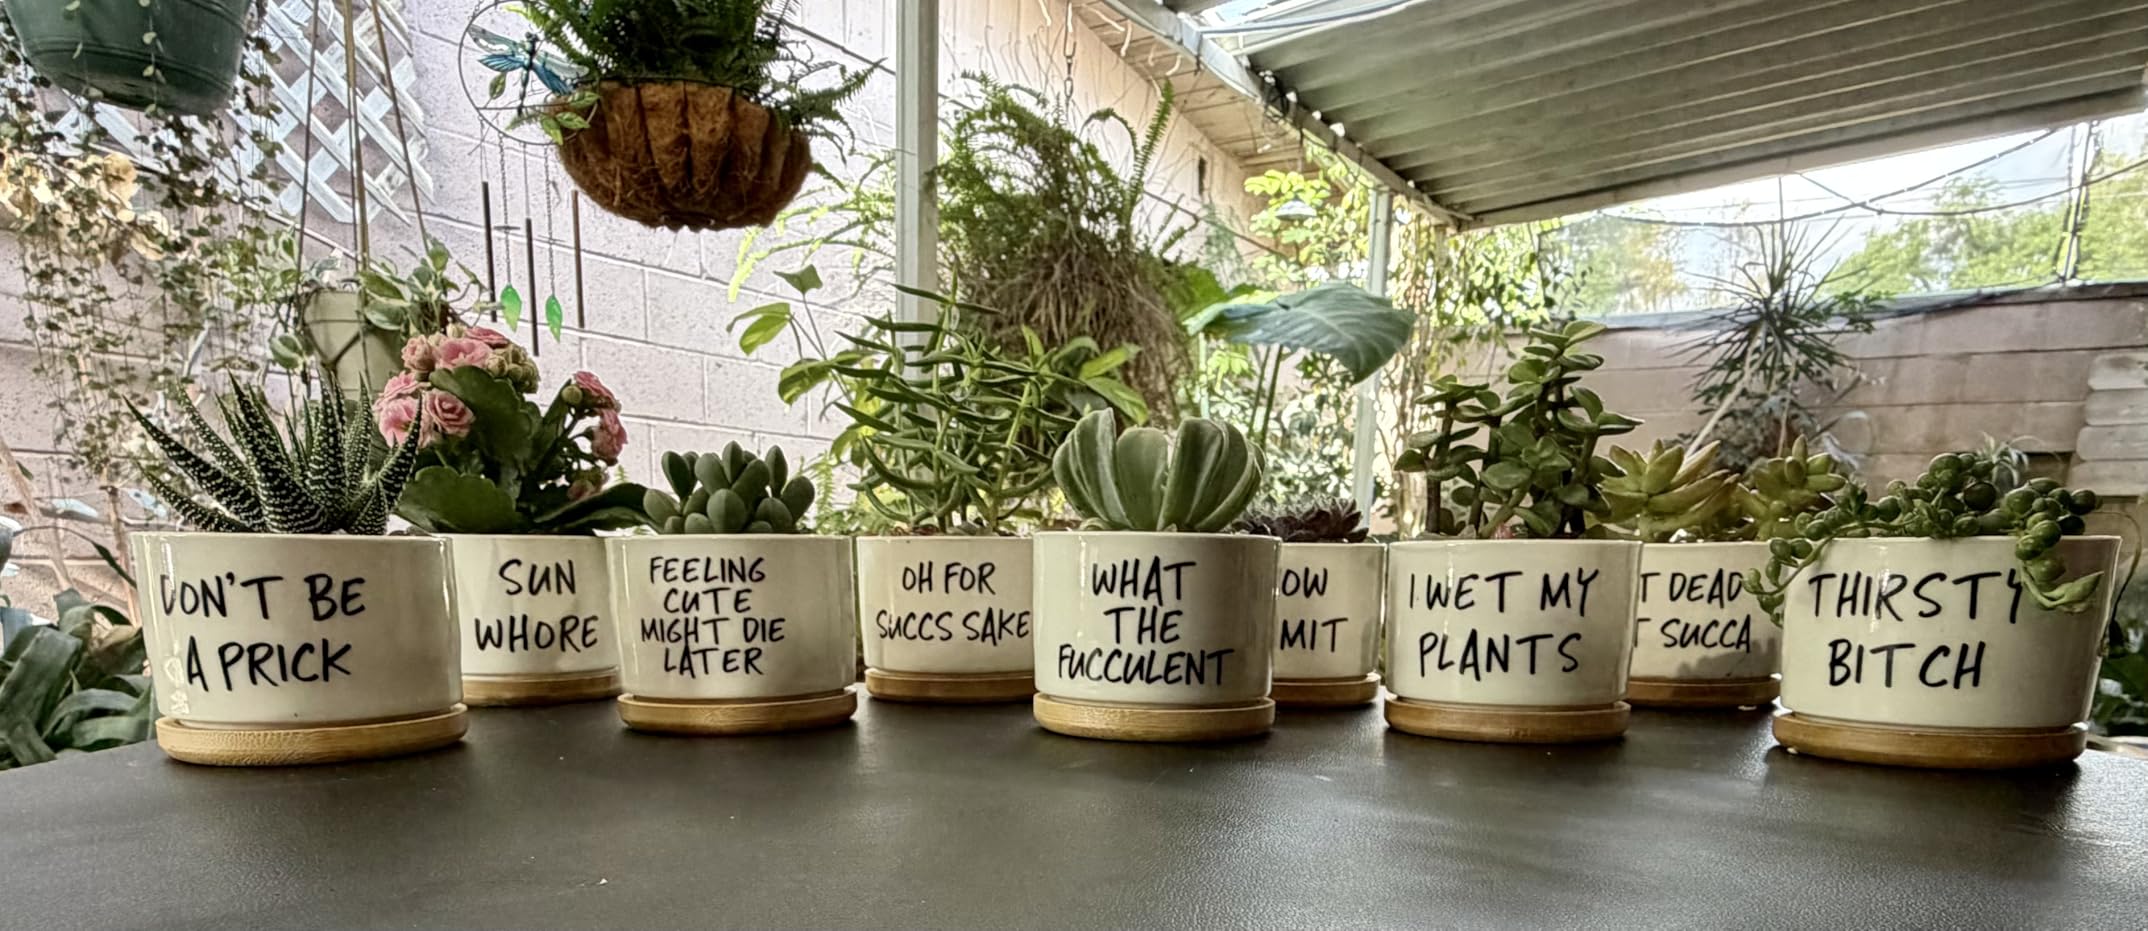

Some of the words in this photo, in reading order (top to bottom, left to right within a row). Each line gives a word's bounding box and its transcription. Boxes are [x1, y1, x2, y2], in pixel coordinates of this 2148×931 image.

[498, 558, 576, 596] SUN
[650, 556, 766, 584] FEELING
[902, 560, 933, 594] OH
[944, 561, 996, 595] FOR
[1092, 555, 1197, 607] WHAT
[1669, 567, 1743, 609] DEAD
[160, 571, 285, 620] DON'T
[303, 572, 367, 623] BE
[663, 587, 753, 614] CUTE
[1426, 571, 1523, 613] WET
[1539, 567, 1600, 618] MY
[1807, 567, 2023, 624] THIRSTY
[475, 613, 599, 653] WHORE
[640, 616, 730, 646] MIGHT
[742, 616, 786, 644] DIE
[876, 609, 953, 642] SUCCS
[962, 607, 1031, 647] SAKE
[1103, 605, 1184, 645] THE
[1660, 613, 1751, 653] SUCCA
[187, 635, 209, 692] A
[217, 637, 353, 692] PRICK
[663, 643, 764, 679] LATER
[1058, 643, 1235, 687] FUCCULENT
[1419, 628, 1583, 682] PLANTS
[1828, 638, 1987, 690] BITCH
